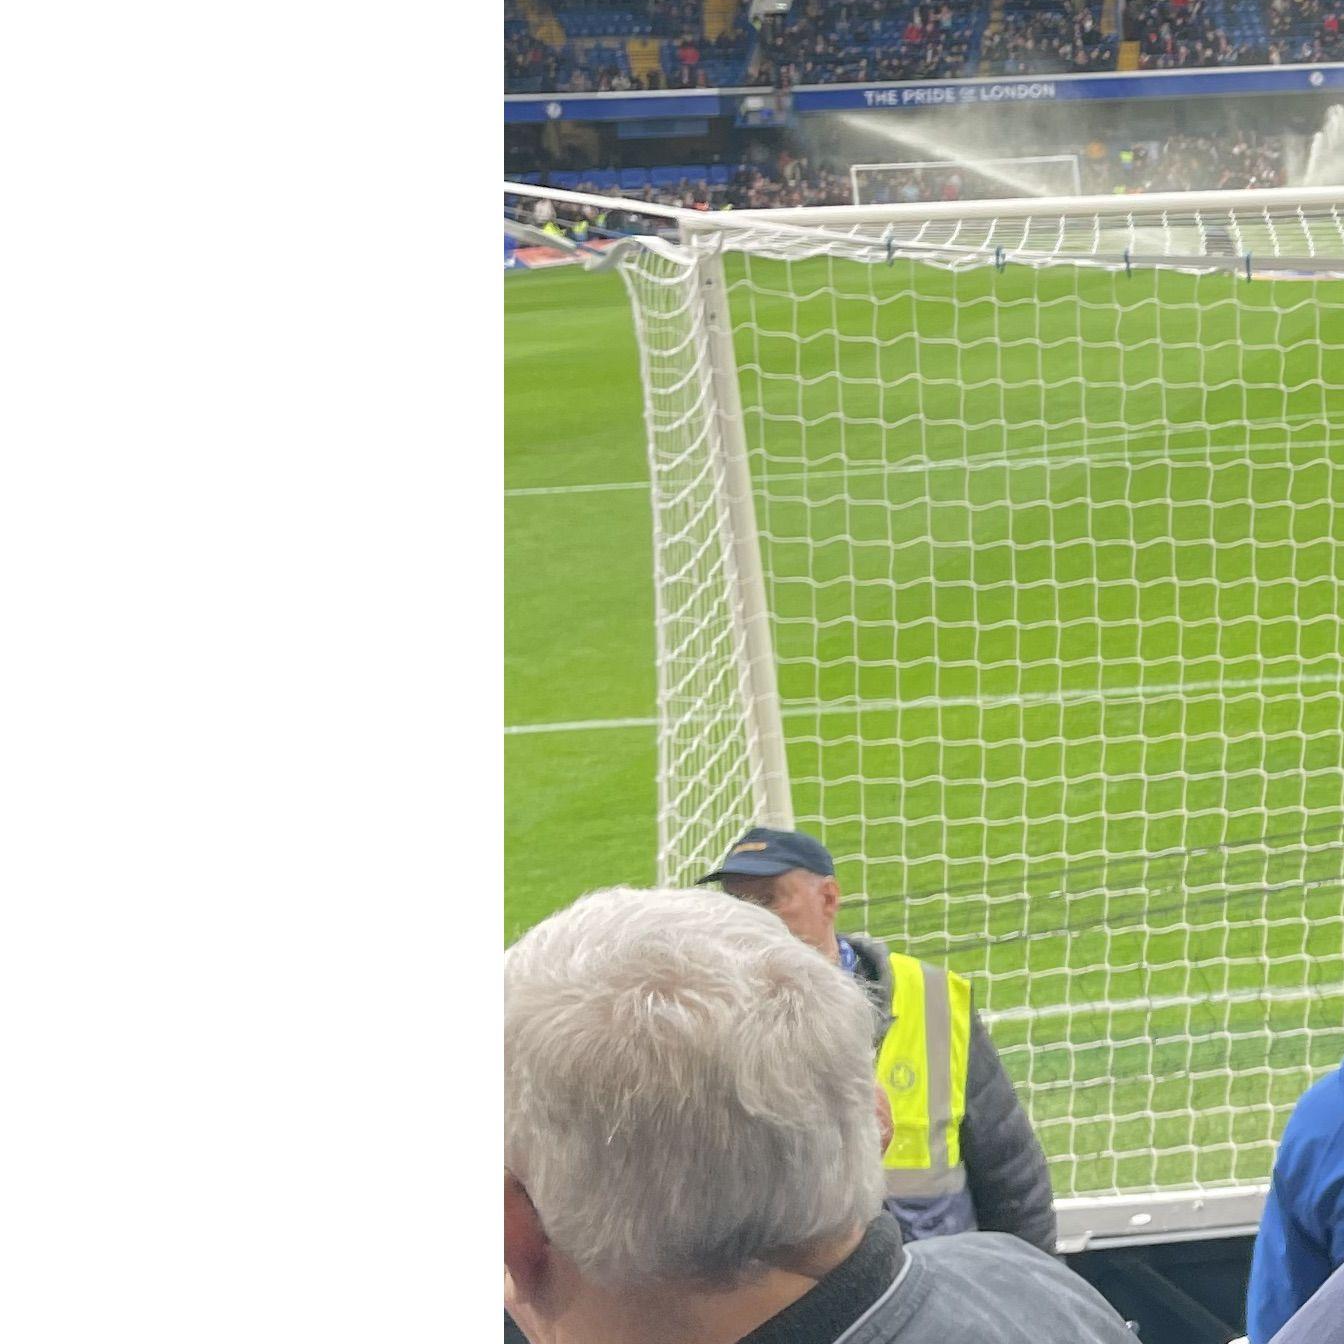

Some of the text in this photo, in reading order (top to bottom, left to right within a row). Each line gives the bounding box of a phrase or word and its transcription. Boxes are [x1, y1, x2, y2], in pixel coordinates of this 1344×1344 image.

[864, 91, 898, 105] THE
[901, 87, 955, 105] PRIDE
[980, 83, 1055, 101] LONDON
